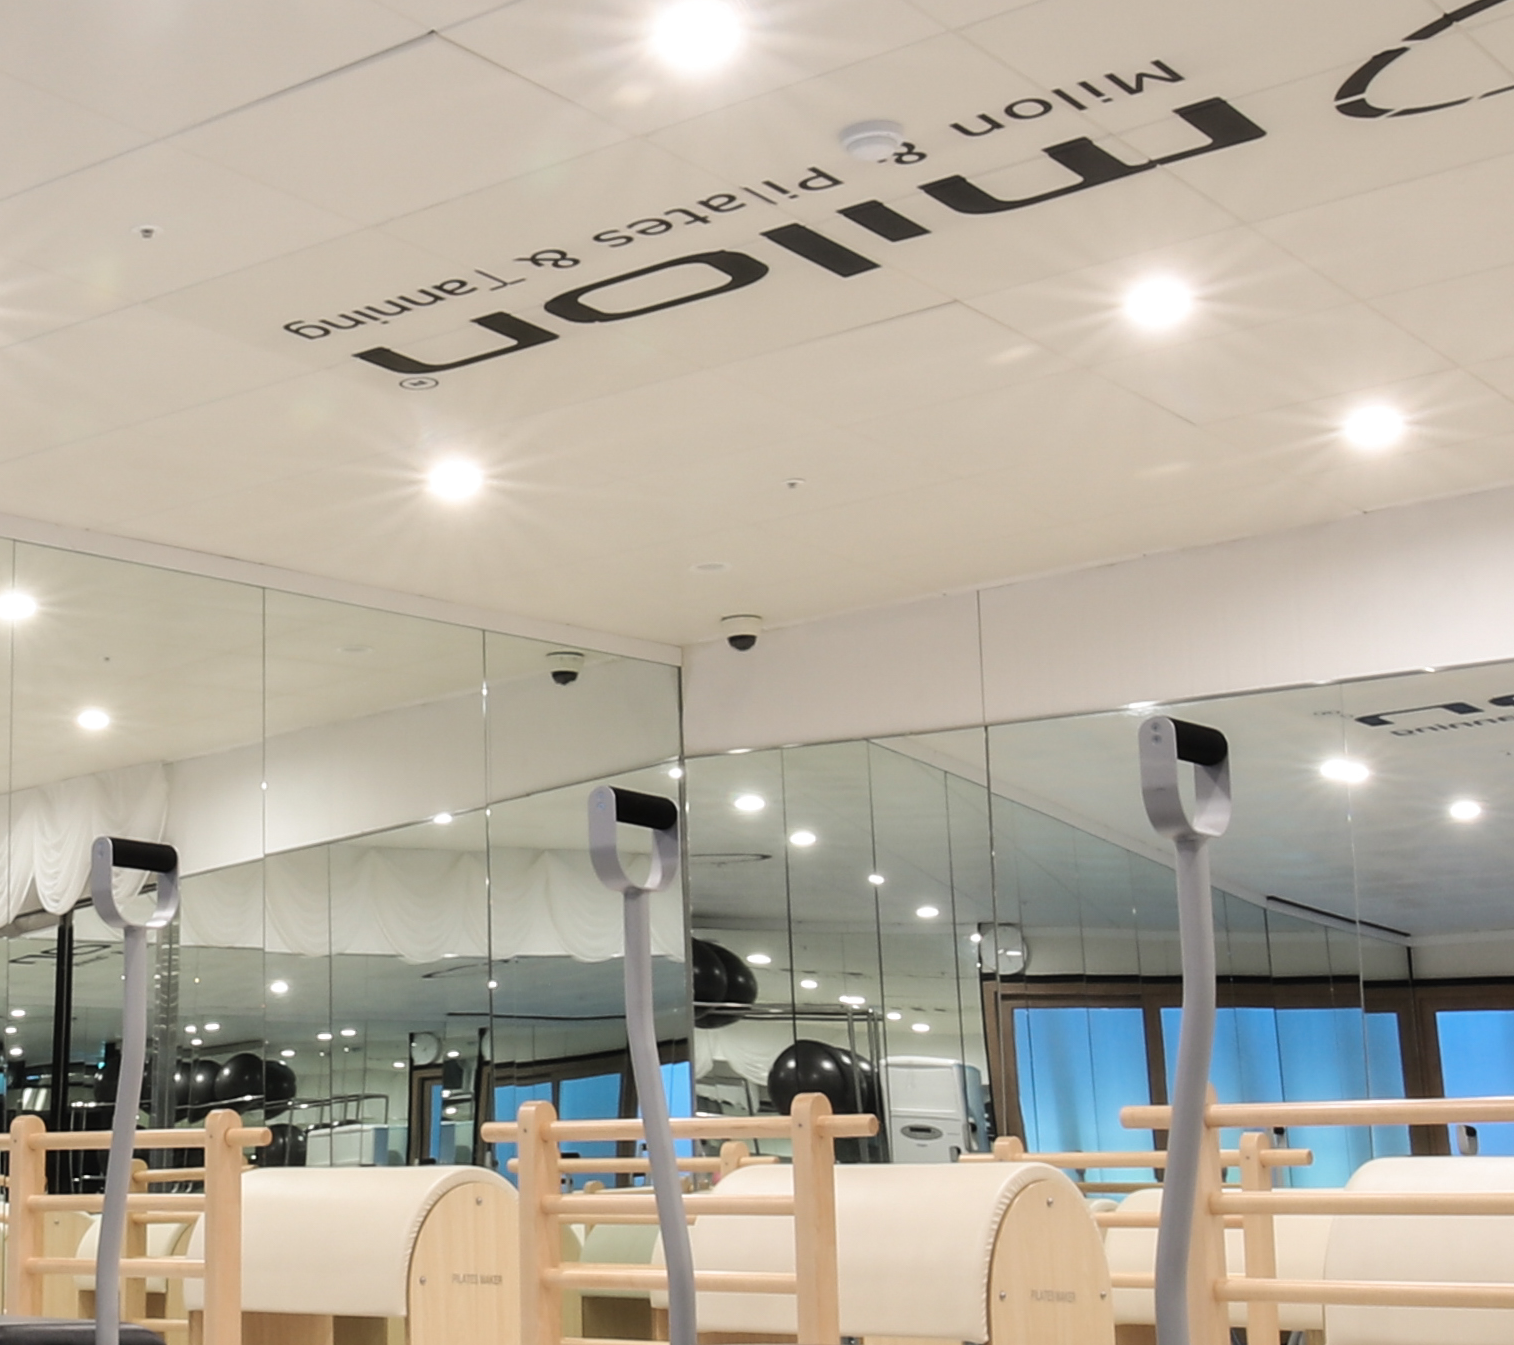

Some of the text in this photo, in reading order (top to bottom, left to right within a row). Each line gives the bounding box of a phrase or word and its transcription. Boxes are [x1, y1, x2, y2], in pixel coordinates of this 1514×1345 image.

[949, 60, 1185, 137] Milon
[592, 167, 844, 248] Pilates
[513, 249, 581, 269] &
[283, 270, 526, 340] Tanning
